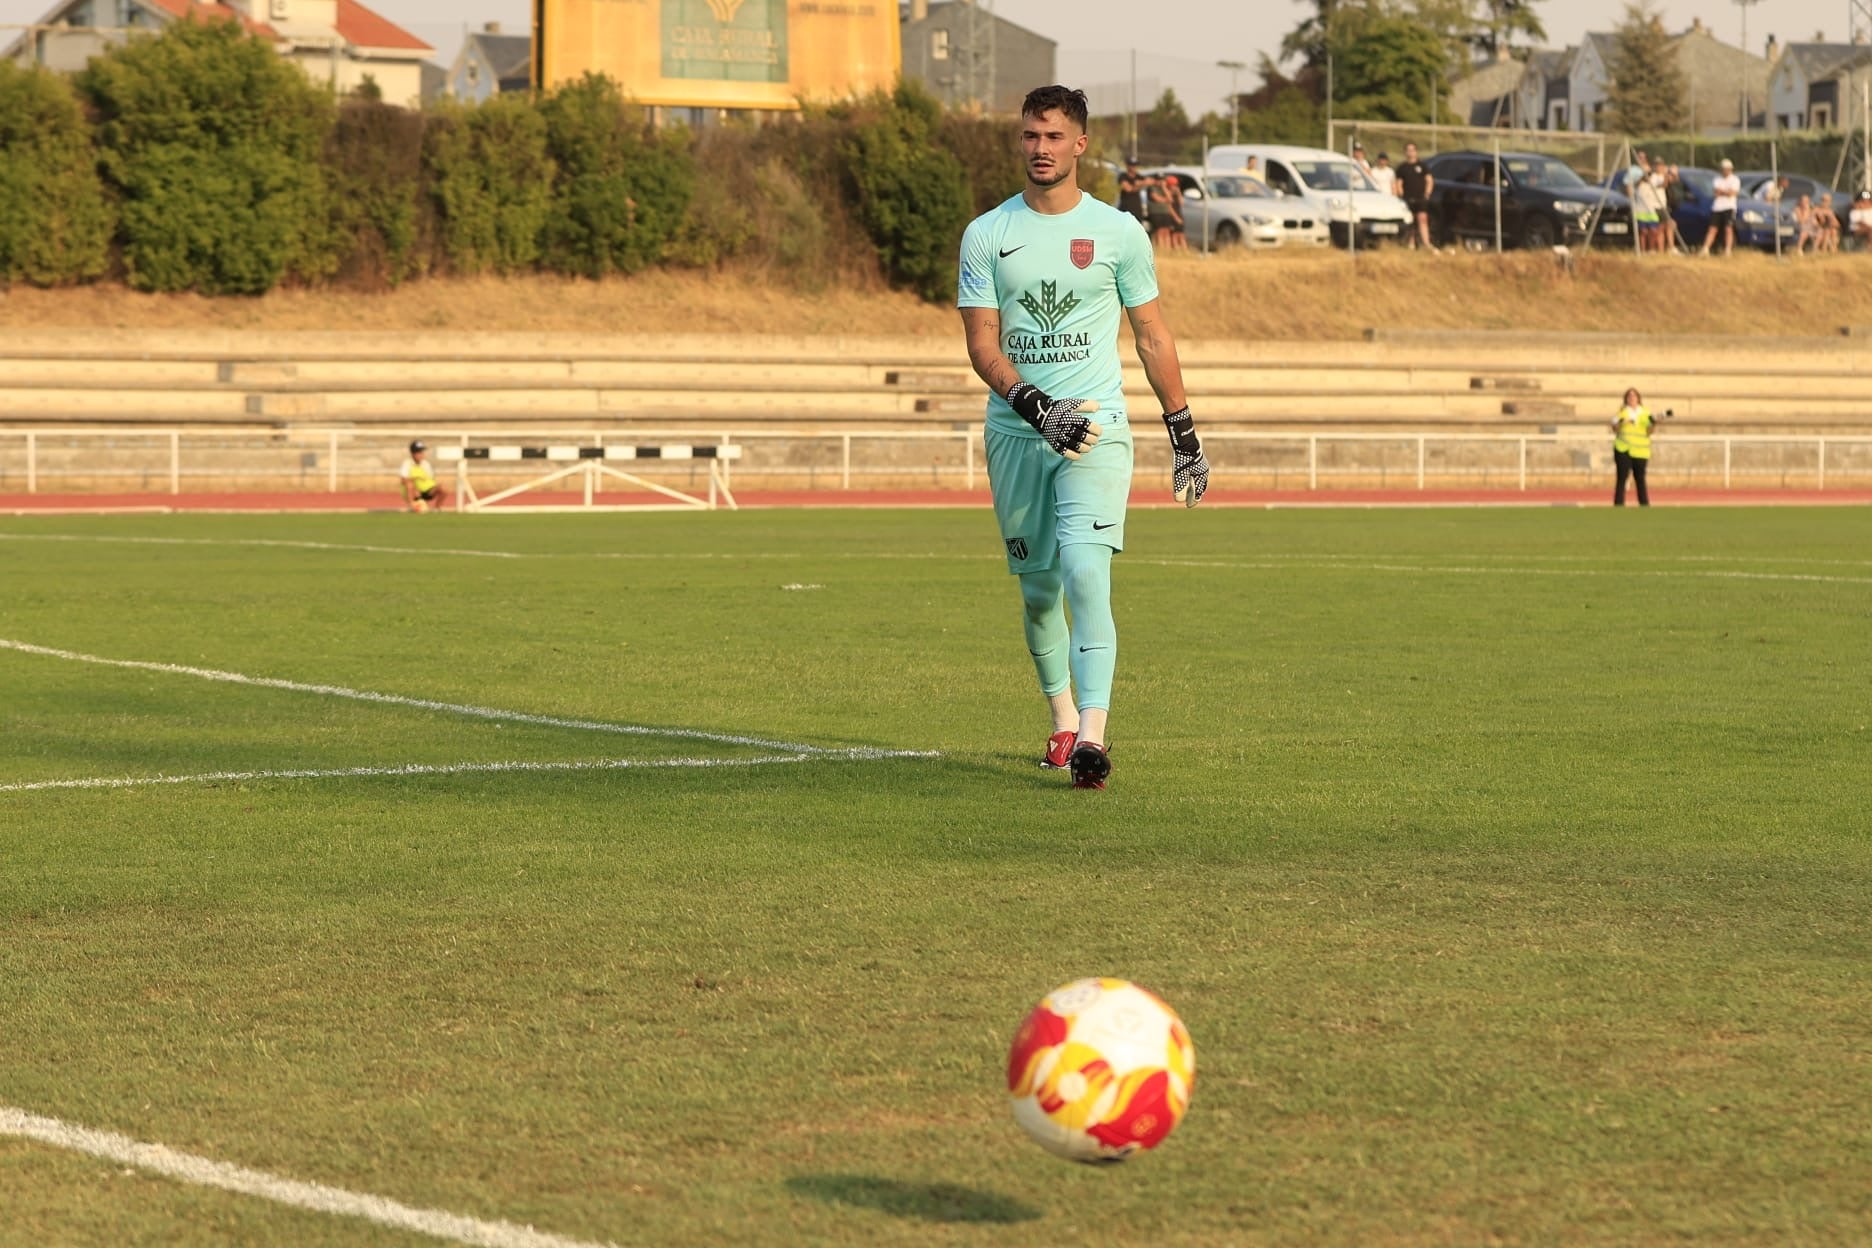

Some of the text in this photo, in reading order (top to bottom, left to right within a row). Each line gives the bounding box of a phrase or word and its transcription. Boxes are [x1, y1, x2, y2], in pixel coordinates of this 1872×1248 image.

[1008, 332, 1091, 353] CAJA RURAL
[1008, 348, 1090, 364] DE SALAMANCA
